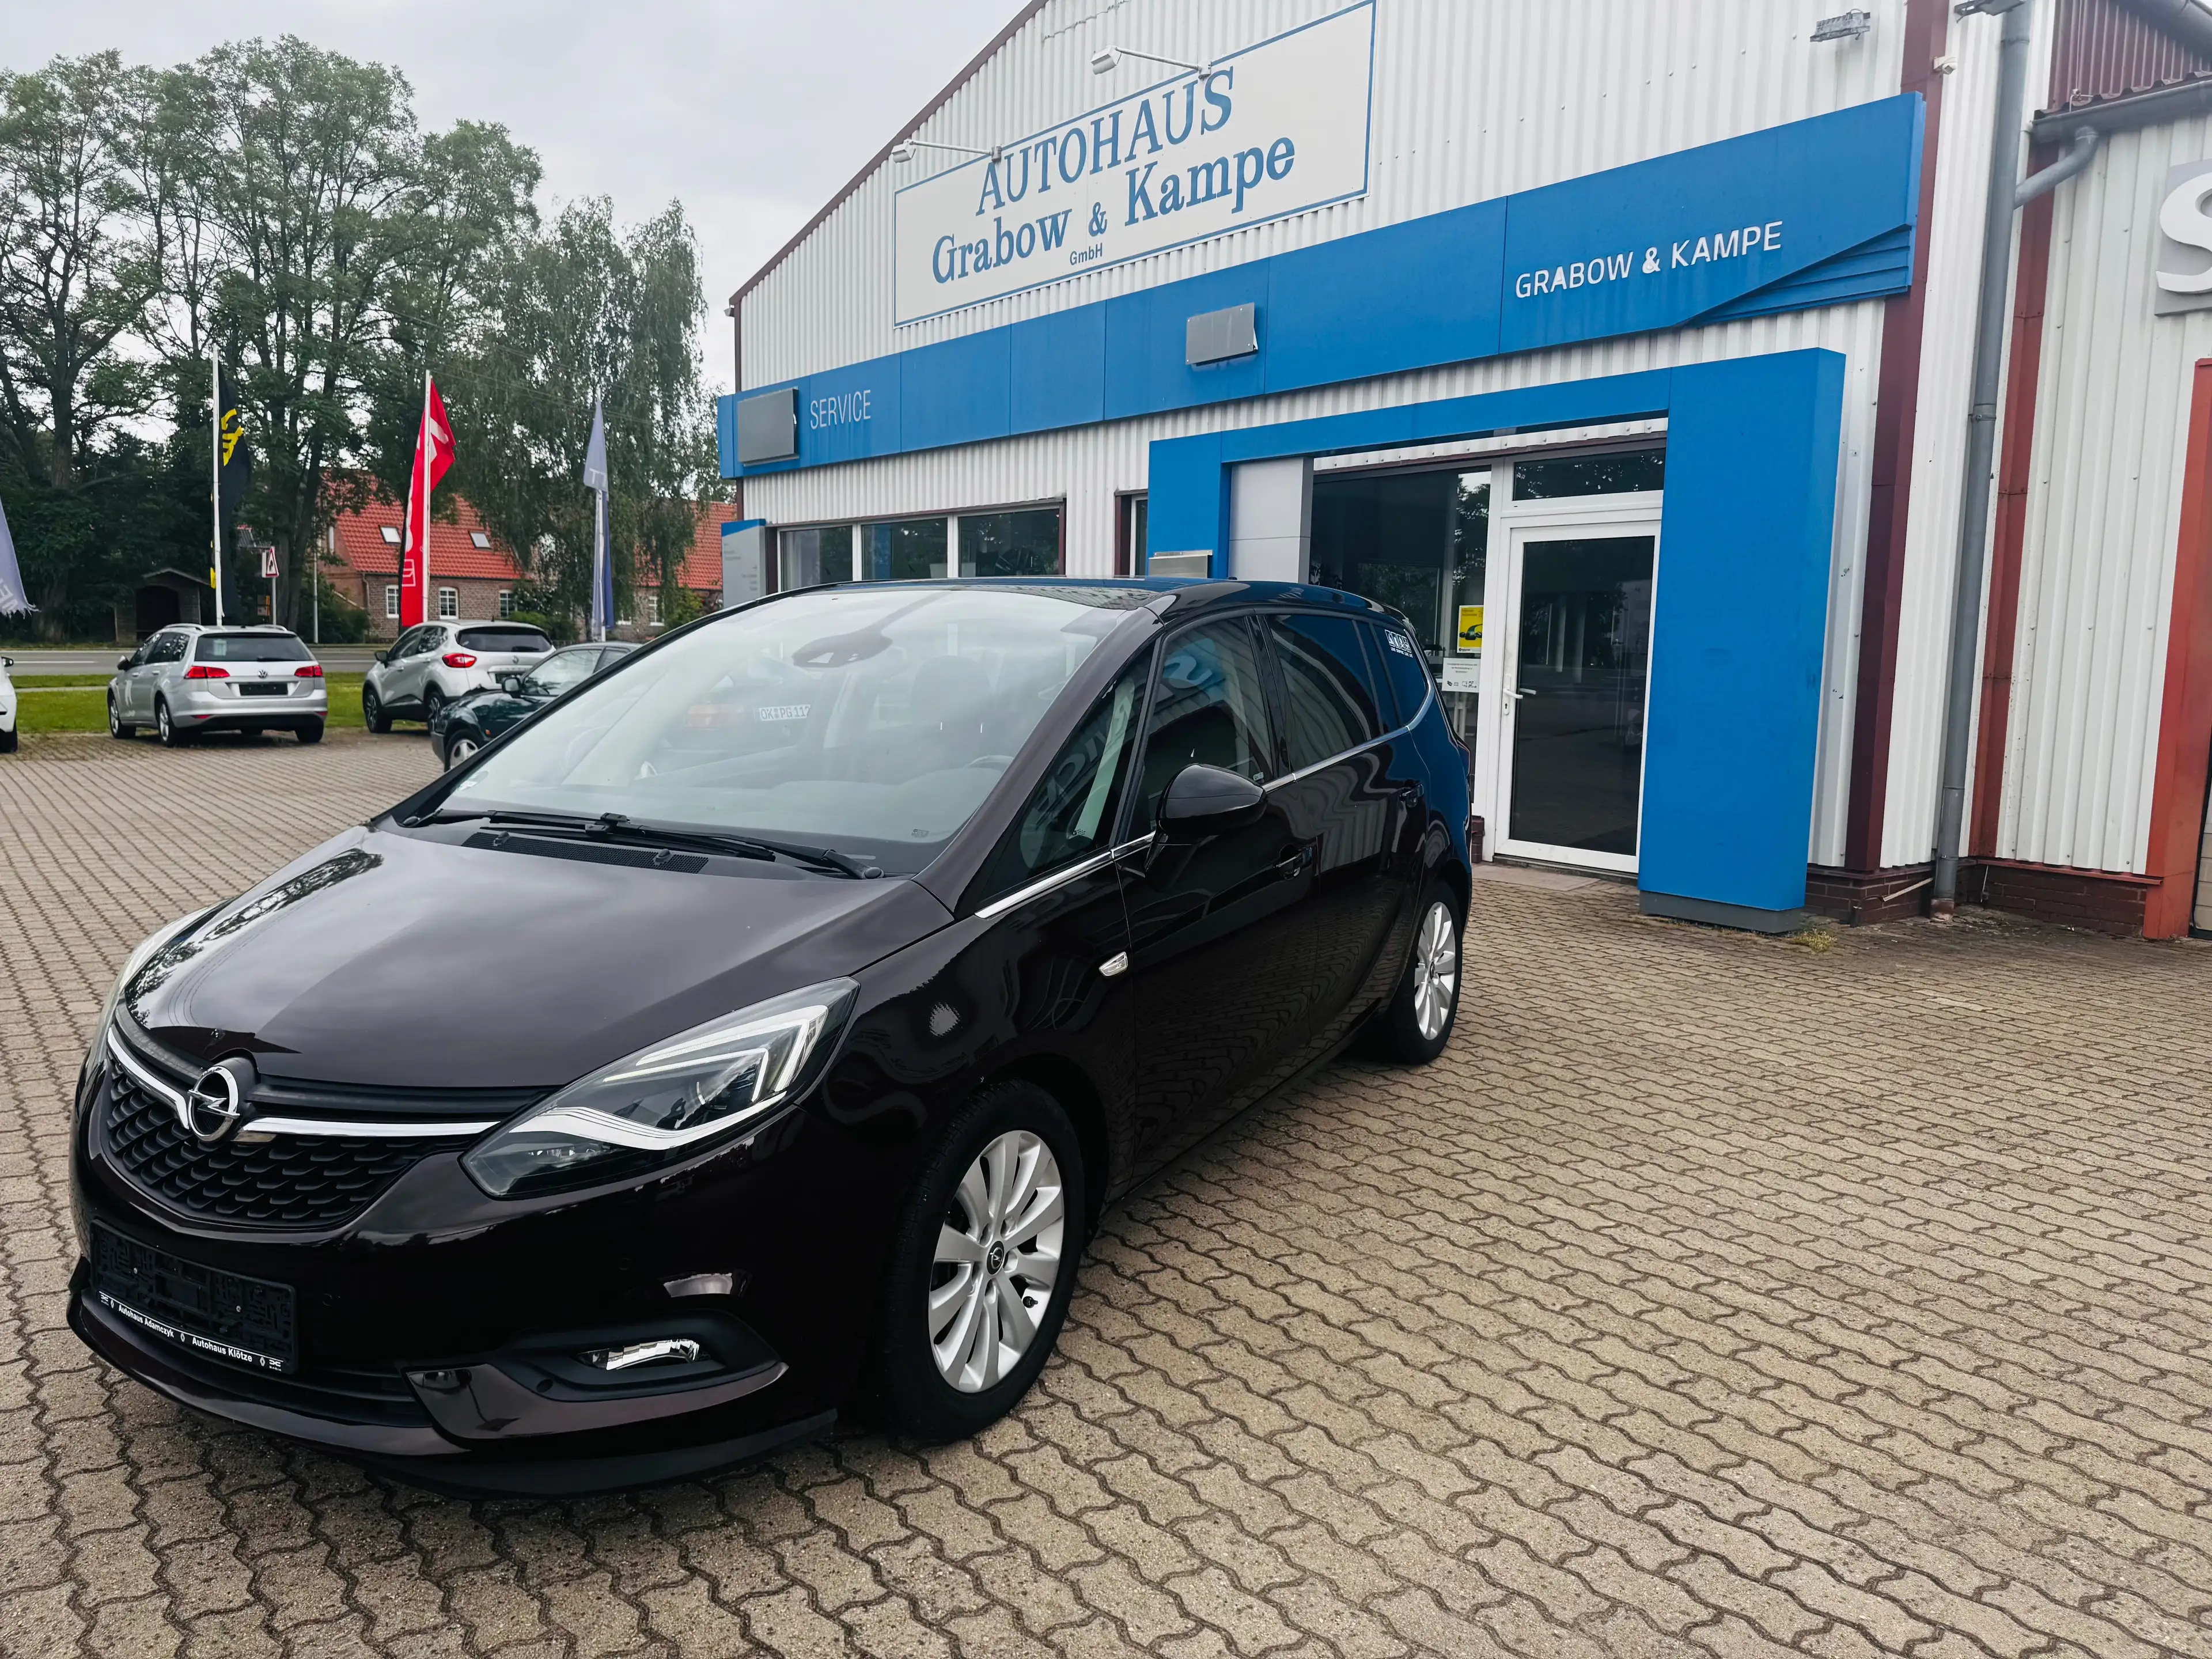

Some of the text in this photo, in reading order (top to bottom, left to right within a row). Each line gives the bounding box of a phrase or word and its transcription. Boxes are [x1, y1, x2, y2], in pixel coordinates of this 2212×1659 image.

[975, 66, 1234, 217] AUTOHAUS
[932, 137, 1296, 284] Grabow & Kampe
[1069, 243, 1104, 266] GmbH
[1515, 220, 1783, 298] GRABOW & KAMPE
[810, 389, 871, 430] SERVICE
[760, 709, 774, 719] OK
[779, 707, 793, 718] PG
[118, 1304, 252, 1362] Autohaus Adamczyk Autohaus Klötze
